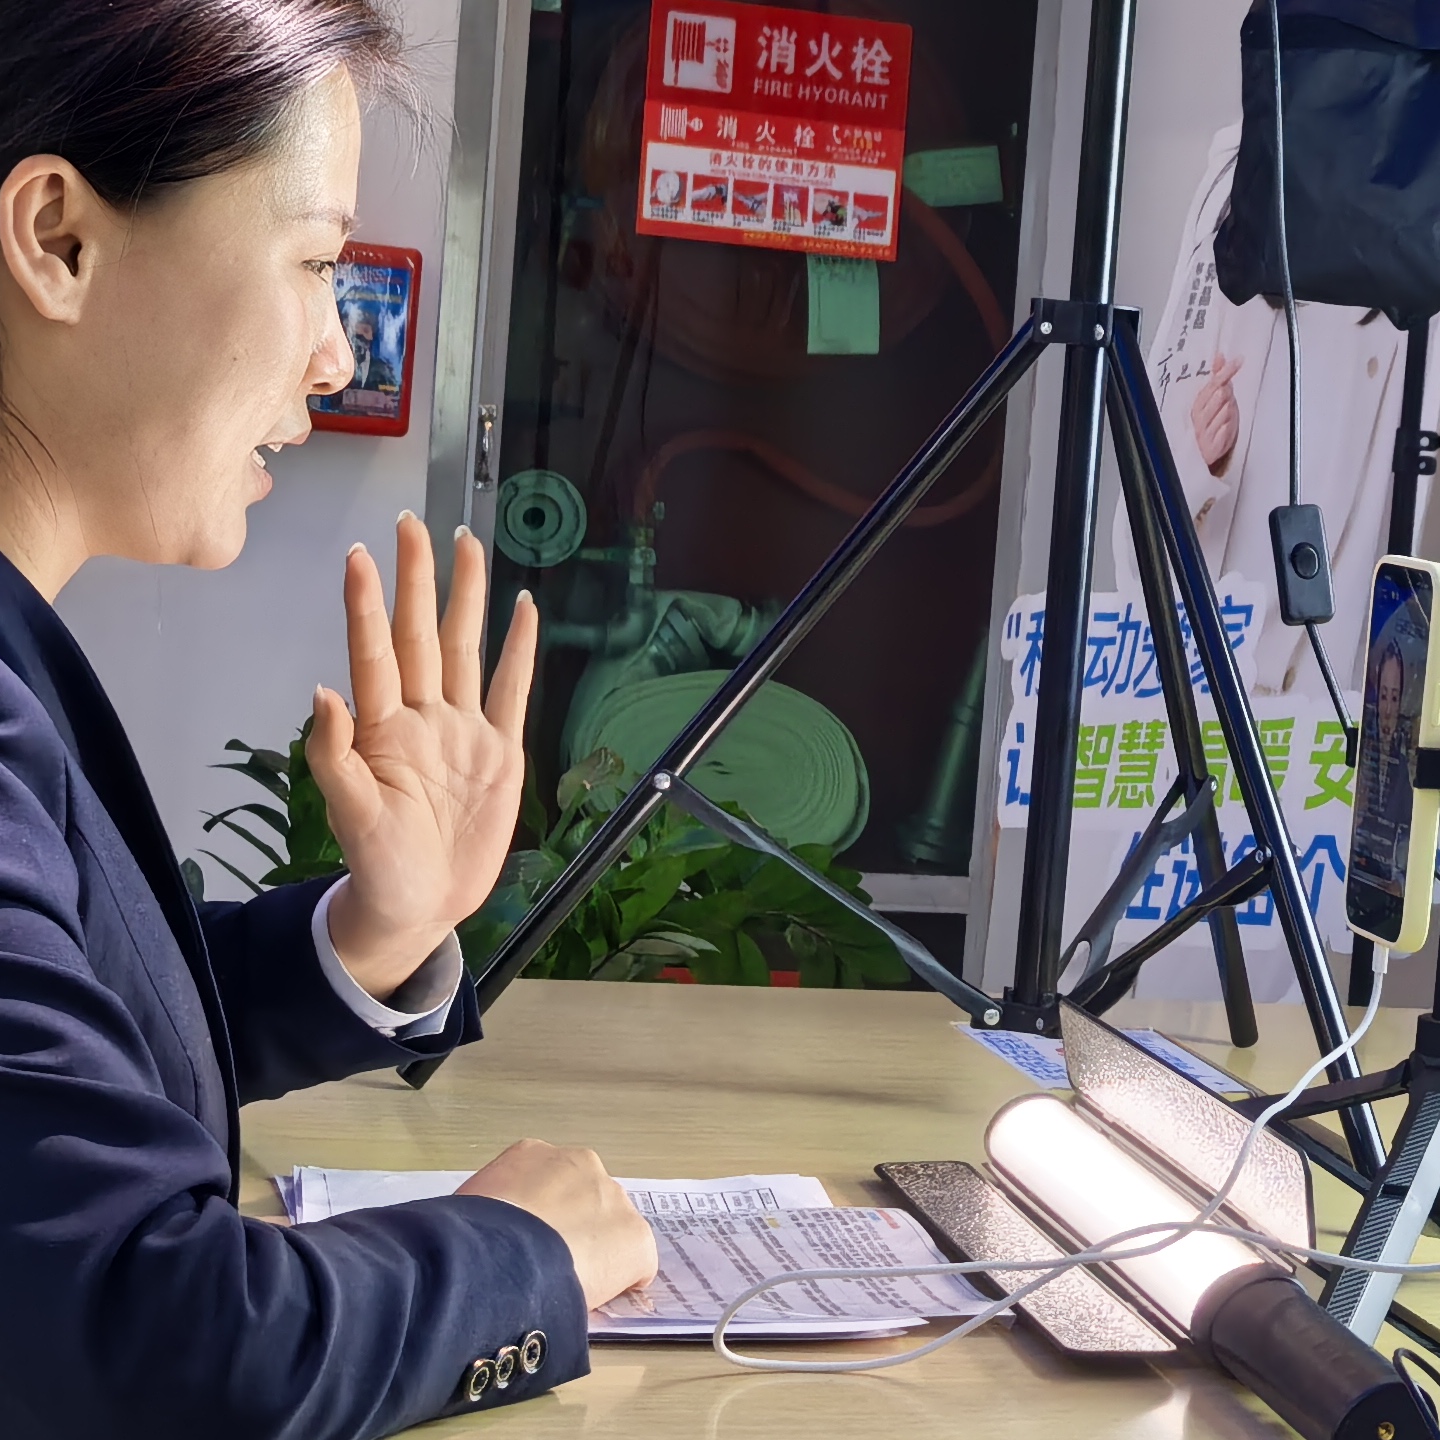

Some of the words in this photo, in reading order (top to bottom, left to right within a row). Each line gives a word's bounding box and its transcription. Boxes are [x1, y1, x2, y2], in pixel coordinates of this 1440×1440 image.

[757, 25, 893, 86] 消火栓
[754, 77, 793, 99] FIRE
[717, 115, 816, 149] 消火栓
